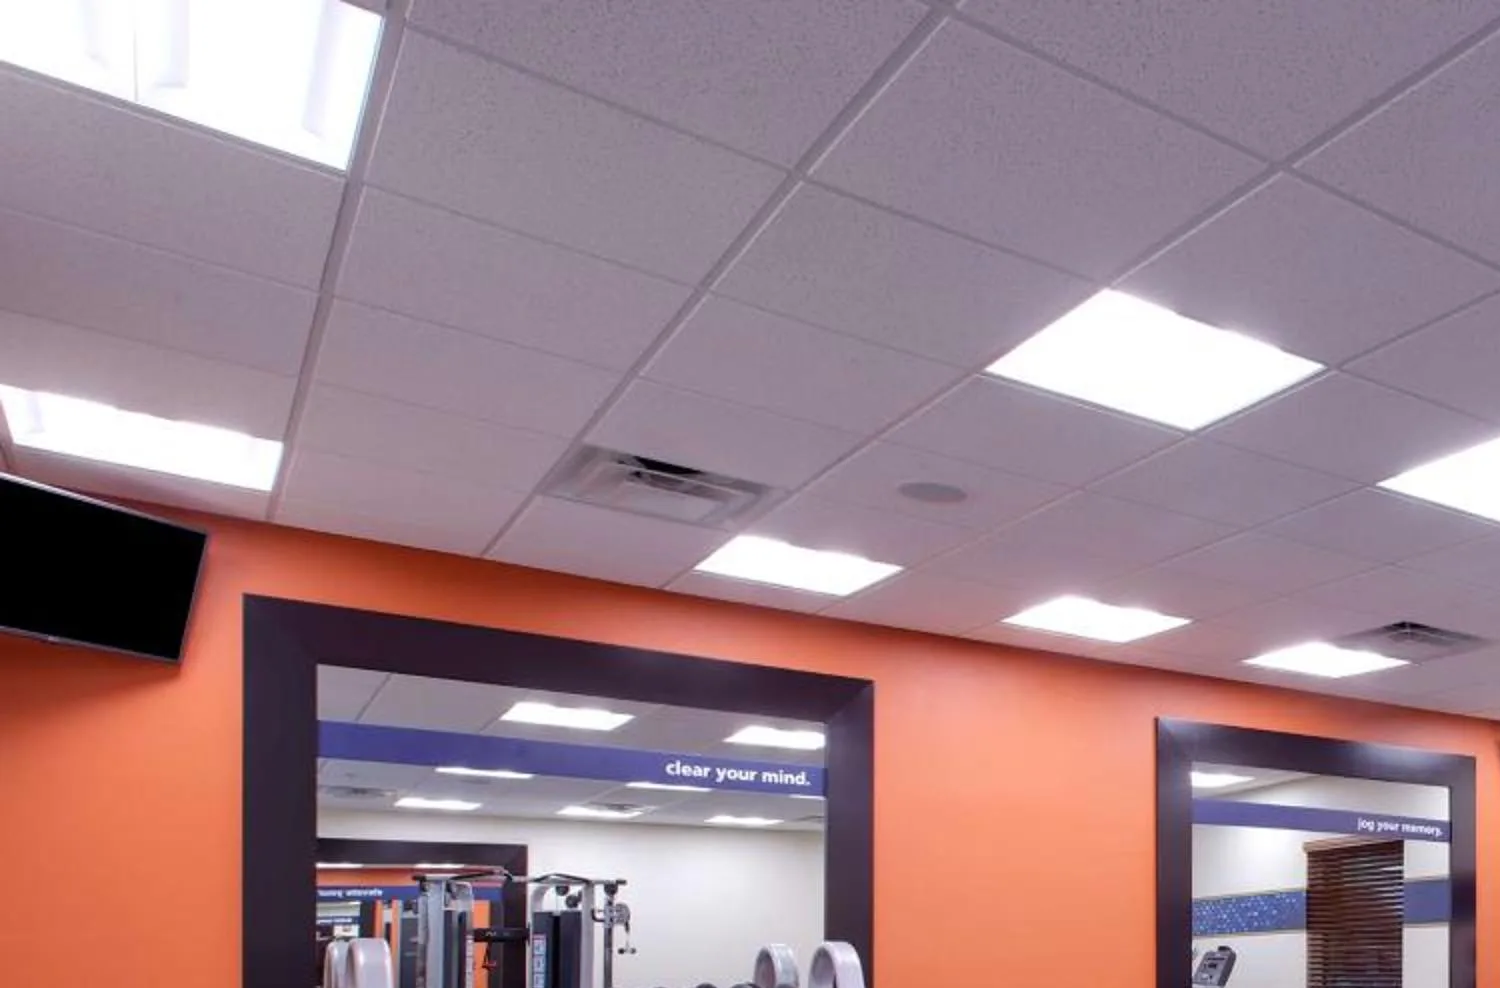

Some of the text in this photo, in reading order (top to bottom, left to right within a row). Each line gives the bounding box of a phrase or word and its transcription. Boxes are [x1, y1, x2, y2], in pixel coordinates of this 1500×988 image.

[665, 760, 812, 786] clear your mind.
[1357, 817, 1375, 832] jog
[1376, 821, 1400, 832] your
